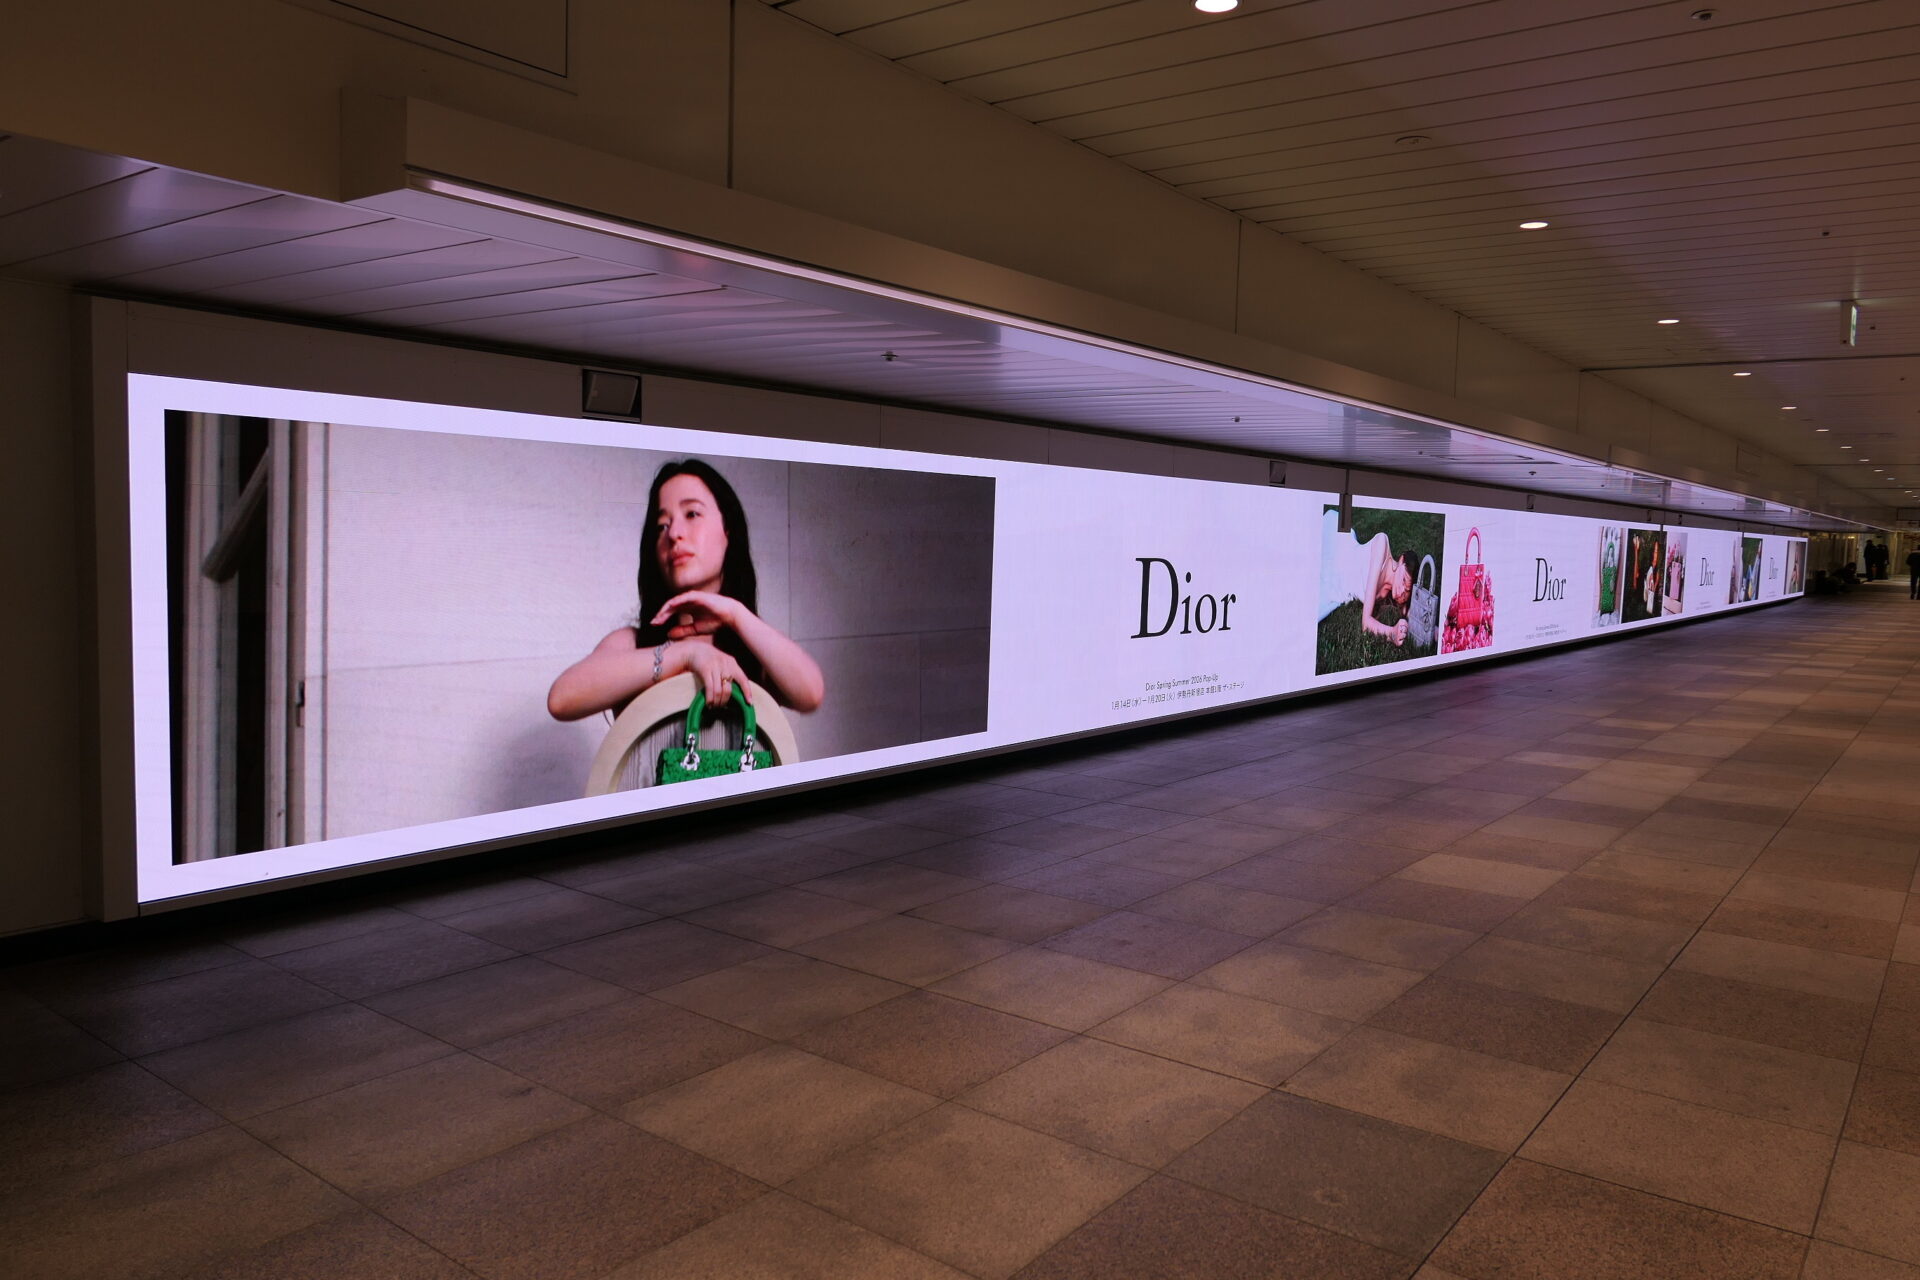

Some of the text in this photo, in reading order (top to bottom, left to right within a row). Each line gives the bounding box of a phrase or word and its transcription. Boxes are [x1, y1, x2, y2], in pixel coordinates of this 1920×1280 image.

[1131, 558, 1236, 639] Dior
[1533, 557, 1566, 602] Dior
[1145, 682, 1156, 691] Dior
[1156, 680, 1172, 689] Spring
[1172, 678, 1190, 687] Summer
